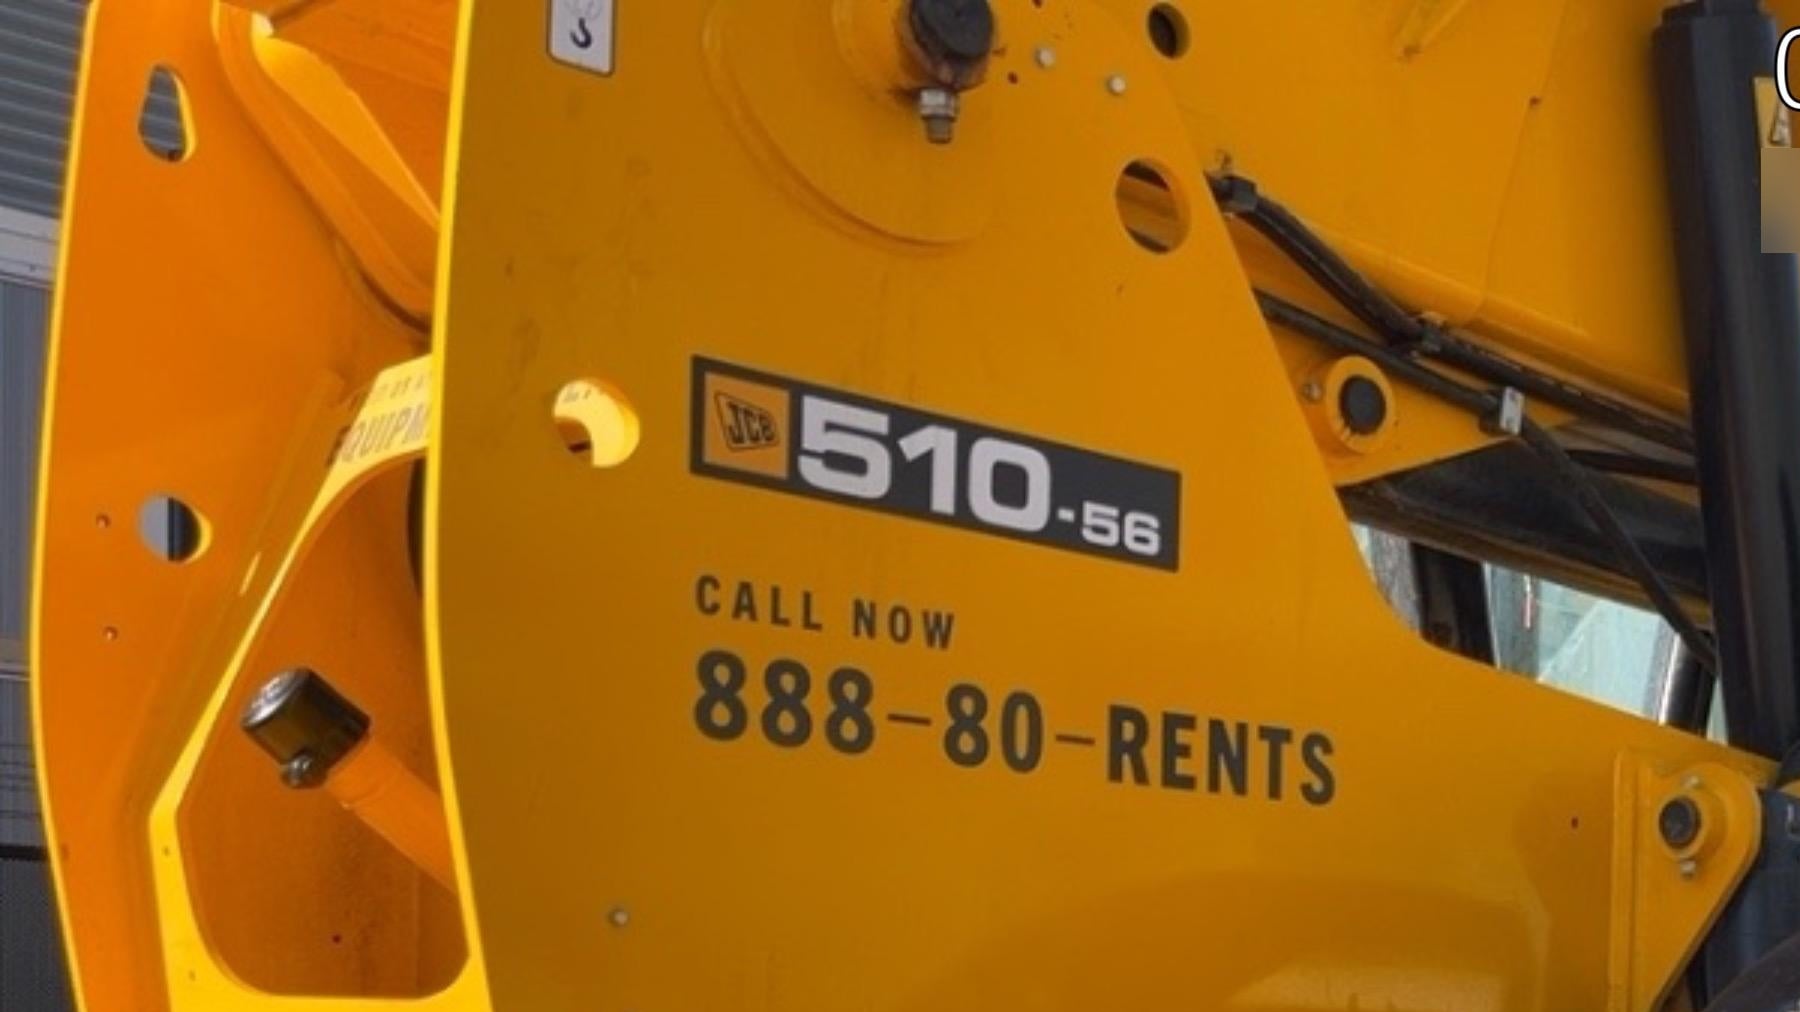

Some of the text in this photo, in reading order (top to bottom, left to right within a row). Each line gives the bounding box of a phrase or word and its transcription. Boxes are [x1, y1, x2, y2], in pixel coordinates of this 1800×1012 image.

[727, 394, 1161, 557] JCB 510-56
[695, 574, 955, 650] CALL NOW
[694, 650, 1336, 806] 888-80-RENTS
